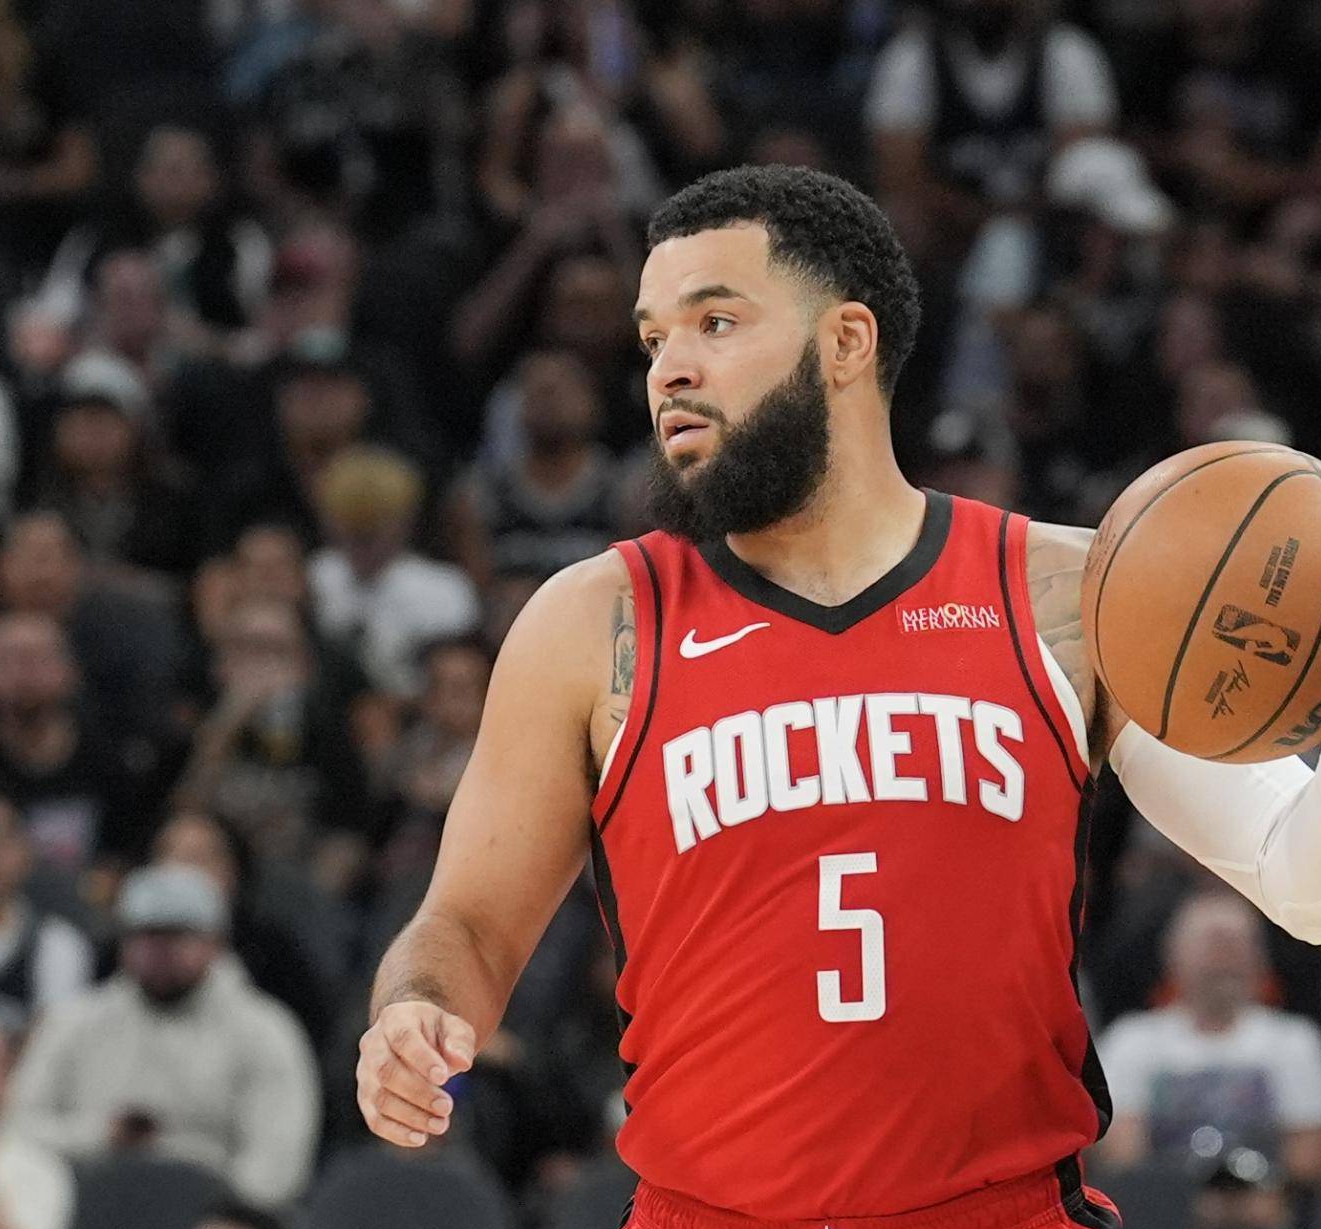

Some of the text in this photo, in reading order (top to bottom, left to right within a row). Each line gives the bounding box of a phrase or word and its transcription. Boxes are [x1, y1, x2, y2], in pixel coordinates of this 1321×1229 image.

[902, 602, 999, 622] MEMORIAL
[903, 615, 1000, 633] HERMANN
[662, 692, 1025, 855] ROCKETS
[816, 851, 887, 1023] 5
